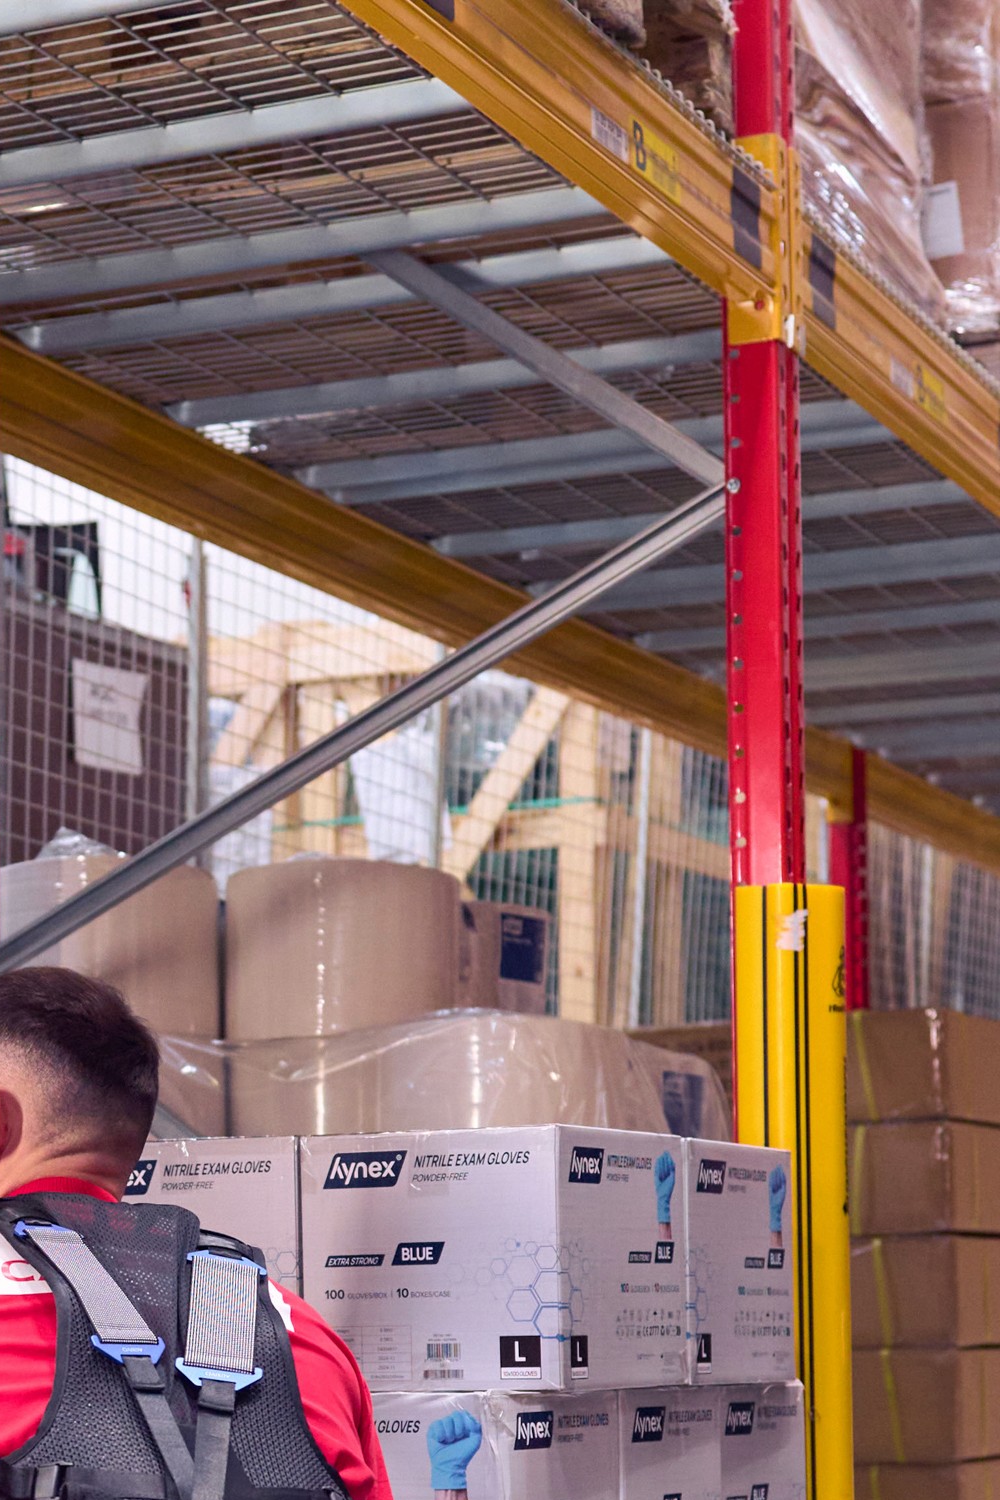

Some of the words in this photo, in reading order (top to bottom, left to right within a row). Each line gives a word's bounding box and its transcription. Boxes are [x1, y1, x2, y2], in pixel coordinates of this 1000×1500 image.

[414, 1155, 453, 1168] NITRILE
[456, 1153, 485, 1166] EXAM
[487, 1151, 530, 1165] GLOVES
[163, 1164, 199, 1177] NITRILE
[201, 1162, 230, 1175] EXAM
[232, 1160, 271, 1174] GLOVES
[412, 1172, 468, 1182] POWDER-FREE
[161, 1181, 214, 1191] POWDER-FREE
[401, 1248, 434, 1261] BLUE
[658, 1247, 671, 1260] BLUE
[328, 1257, 350, 1266] EXTRA
[350, 1257, 378, 1265] STRONG
[325, 1290, 345, 1300] 100
[396, 1288, 409, 1298] 10
[410, 1290, 451, 1298] BOXES/CASE
[514, 1341, 526, 1362] L
[377, 1420, 420, 1434] GLOVES
